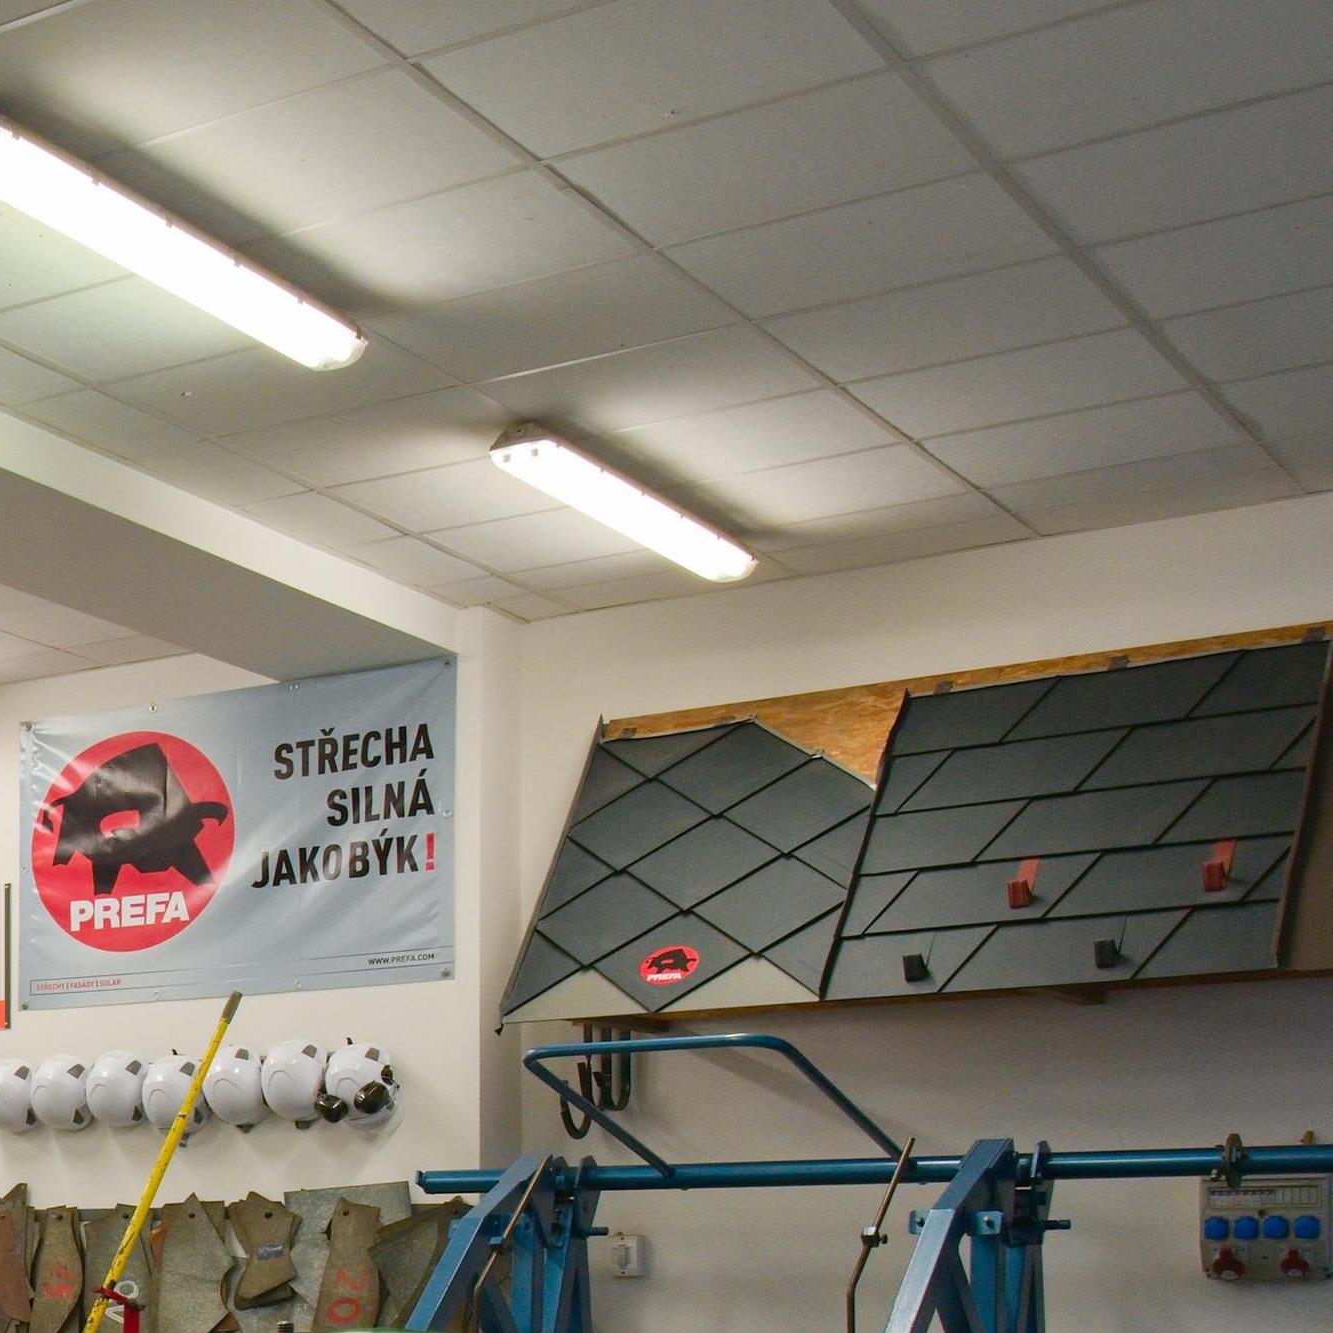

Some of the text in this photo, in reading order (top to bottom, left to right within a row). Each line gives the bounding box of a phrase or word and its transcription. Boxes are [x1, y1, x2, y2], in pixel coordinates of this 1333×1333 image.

[274, 723, 434, 780] STŘECHA
[326, 768, 434, 827] SILNÁ
[70, 891, 190, 932] PREFA
[367, 953, 435, 965] WWW.PREFA.COM
